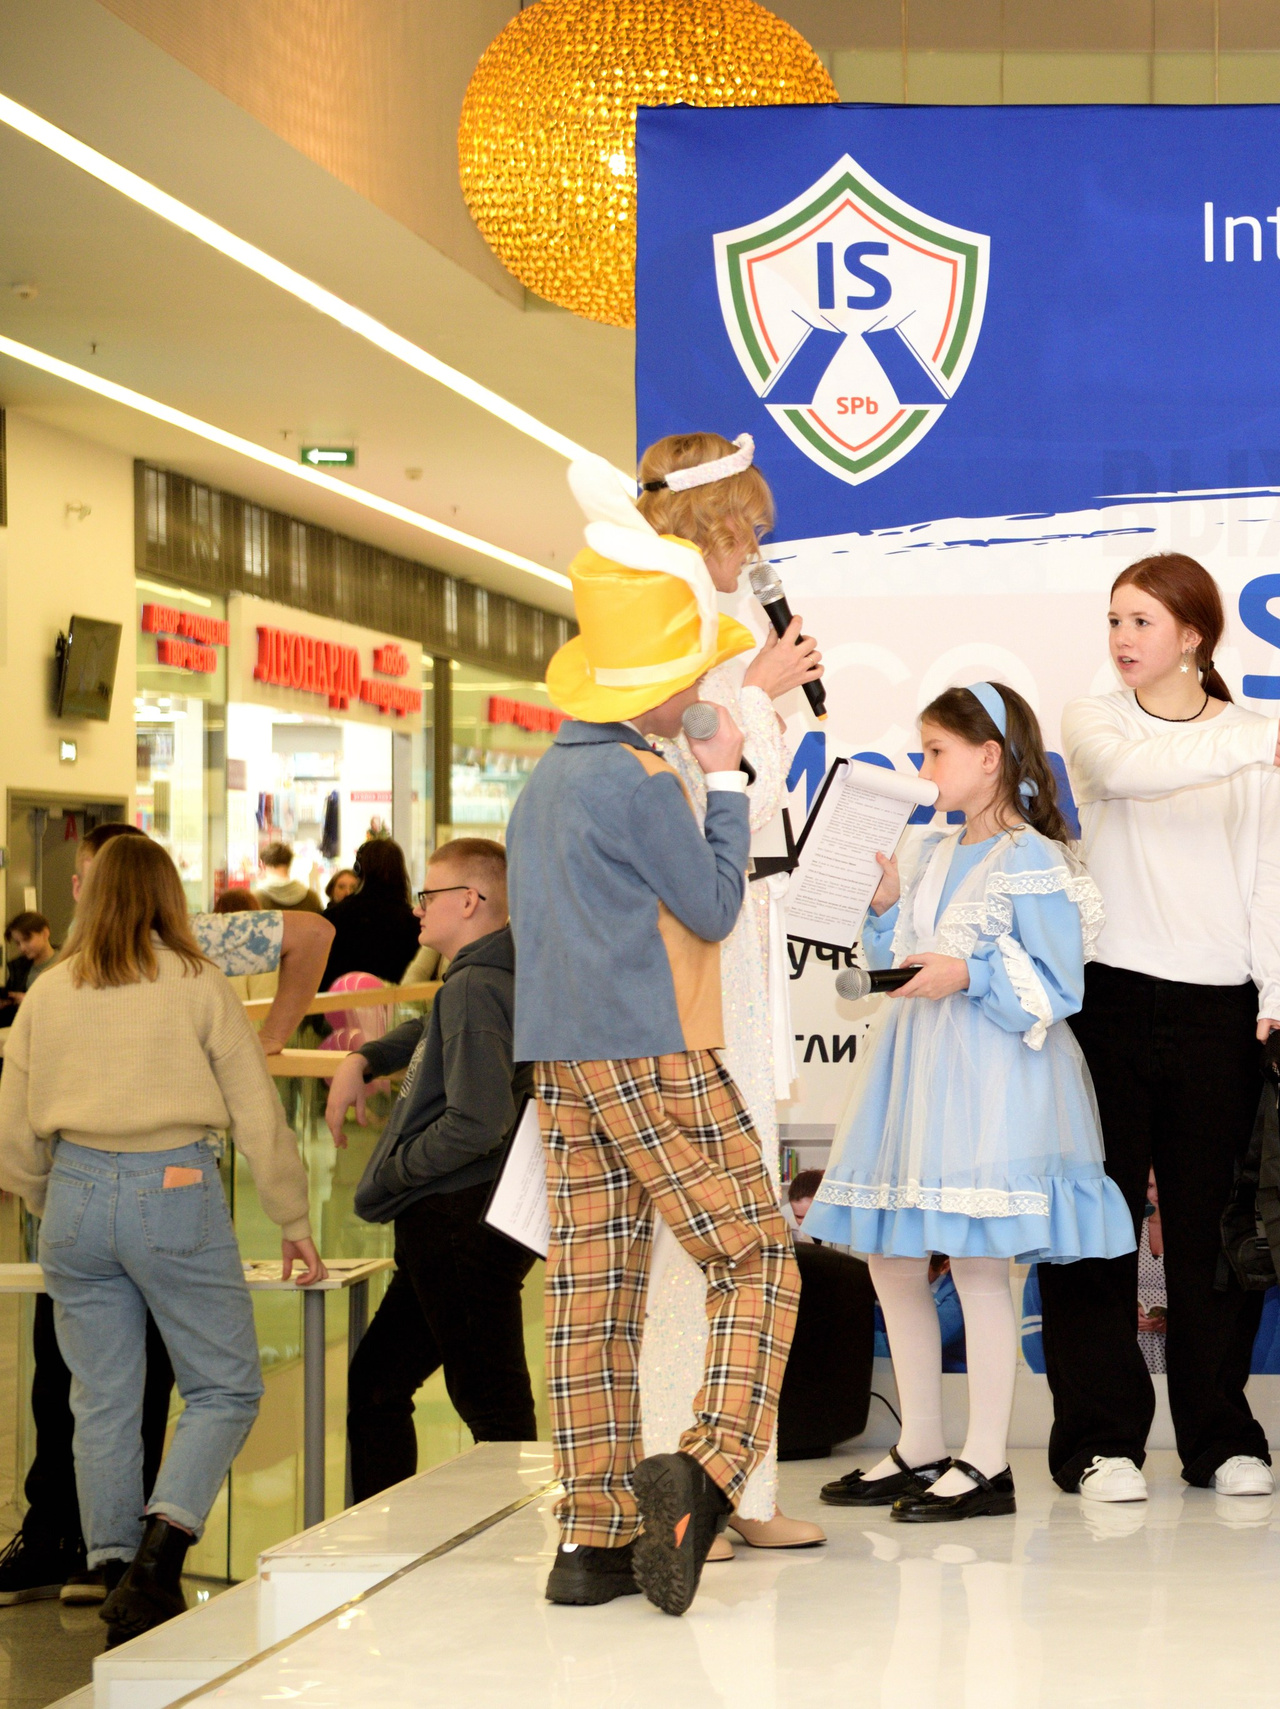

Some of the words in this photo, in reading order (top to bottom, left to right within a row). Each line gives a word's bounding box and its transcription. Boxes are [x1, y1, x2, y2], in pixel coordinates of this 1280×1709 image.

[816, 240, 893, 311] IS
[836, 396, 879, 416] SPb
[254, 626, 362, 711] ЛЕОНАРДО
